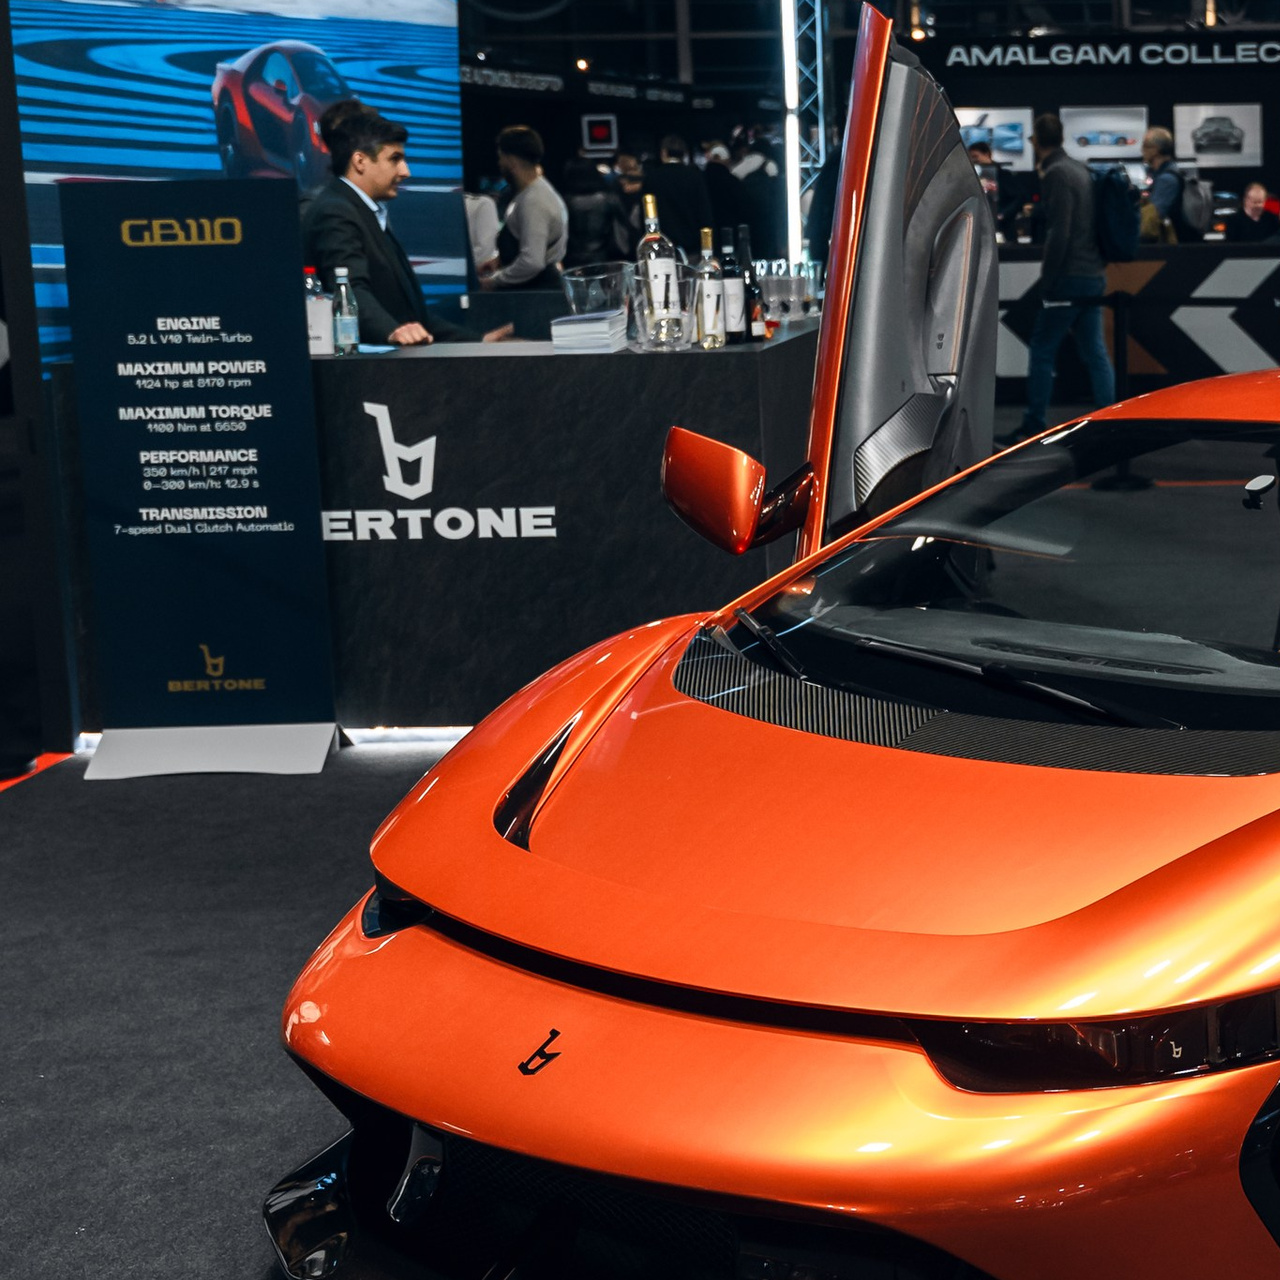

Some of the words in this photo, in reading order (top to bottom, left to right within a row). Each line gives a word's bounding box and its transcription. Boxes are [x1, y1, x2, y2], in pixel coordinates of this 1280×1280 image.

[946, 44, 1131, 66] AMALGAM
[121, 218, 242, 248] GB110
[156, 317, 221, 331] ENGINE
[127, 334, 147, 345] 5.2
[149, 334, 157, 345] L
[160, 333, 182, 344] V10
[185, 332, 253, 344] Twin-Turbo
[117, 362, 205, 376] MAXIMUM
[208, 360, 267, 374] POWER
[135, 379, 161, 389] 1124
[164, 378, 179, 390] hp
[182, 378, 194, 389] at
[197, 377, 225, 388] 8170
[228, 379, 252, 389] rpm
[118, 406, 206, 420] MAXIMUM
[208, 404, 273, 421] TORQUE
[147, 423, 174, 433] 1100
[177, 423, 198, 432] Nm
[200, 422, 212, 432] at
[139, 449, 258, 464] PERFORMANCE
[143, 467, 167, 478] 350
[170, 466, 200, 477] km/h
[209, 465, 230, 476] 217
[232, 465, 258, 477] mph
[188, 479, 222, 490] km/h:
[225, 478, 250, 489] 12.9
[252, 480, 260, 489] s
[139, 506, 268, 520] TRANSMISSION
[165, 523, 192, 533] Dual
[194, 522, 233, 533] Clutch
[236, 521, 295, 532] Automatic
[321, 506, 557, 541] ERTONE
[168, 678, 267, 692] BERTONE
